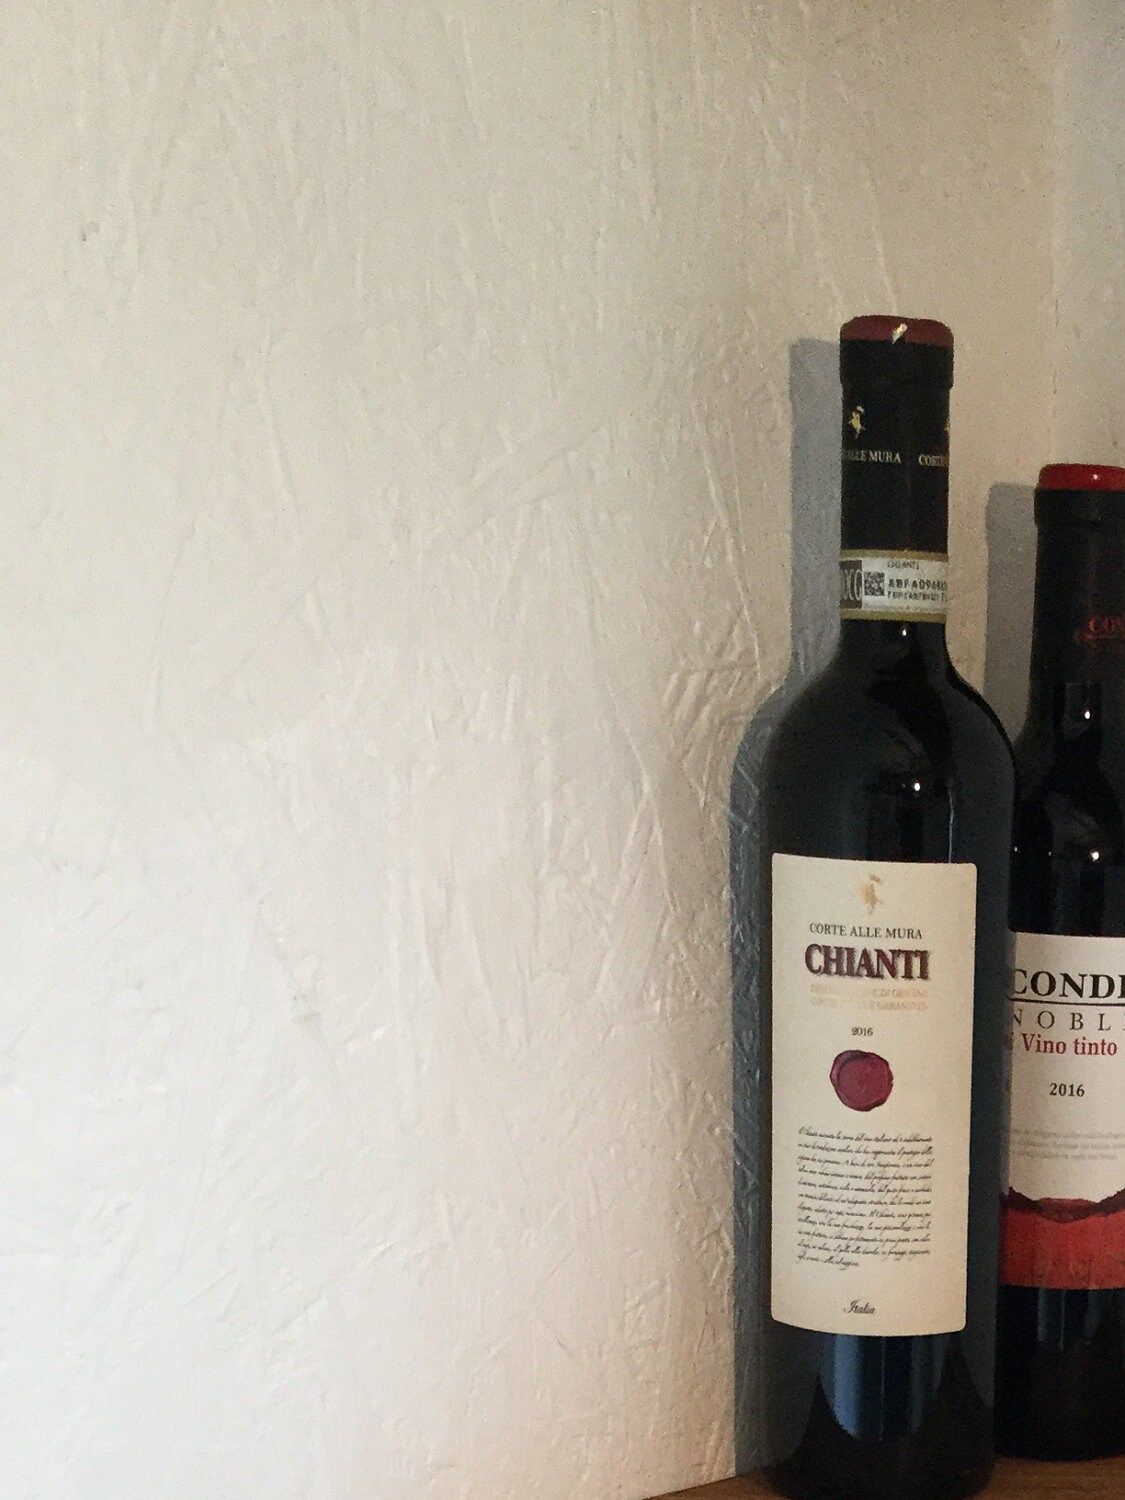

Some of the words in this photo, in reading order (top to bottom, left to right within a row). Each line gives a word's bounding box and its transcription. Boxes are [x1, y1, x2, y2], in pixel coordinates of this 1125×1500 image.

[868, 450, 902, 464] MURA
[809, 922, 847, 936] CORTE
[850, 925, 882, 939] ALLE
[885, 928, 923, 940] MURA
[804, 943, 930, 980] CHIANTI
[851, 1026, 874, 1037] 2016
[1021, 1032, 1067, 1055] Vino
[1073, 1036, 1118, 1056] tinto
[1049, 1082, 1086, 1098] 2016
[843, 1299, 876, 1315] Italia
